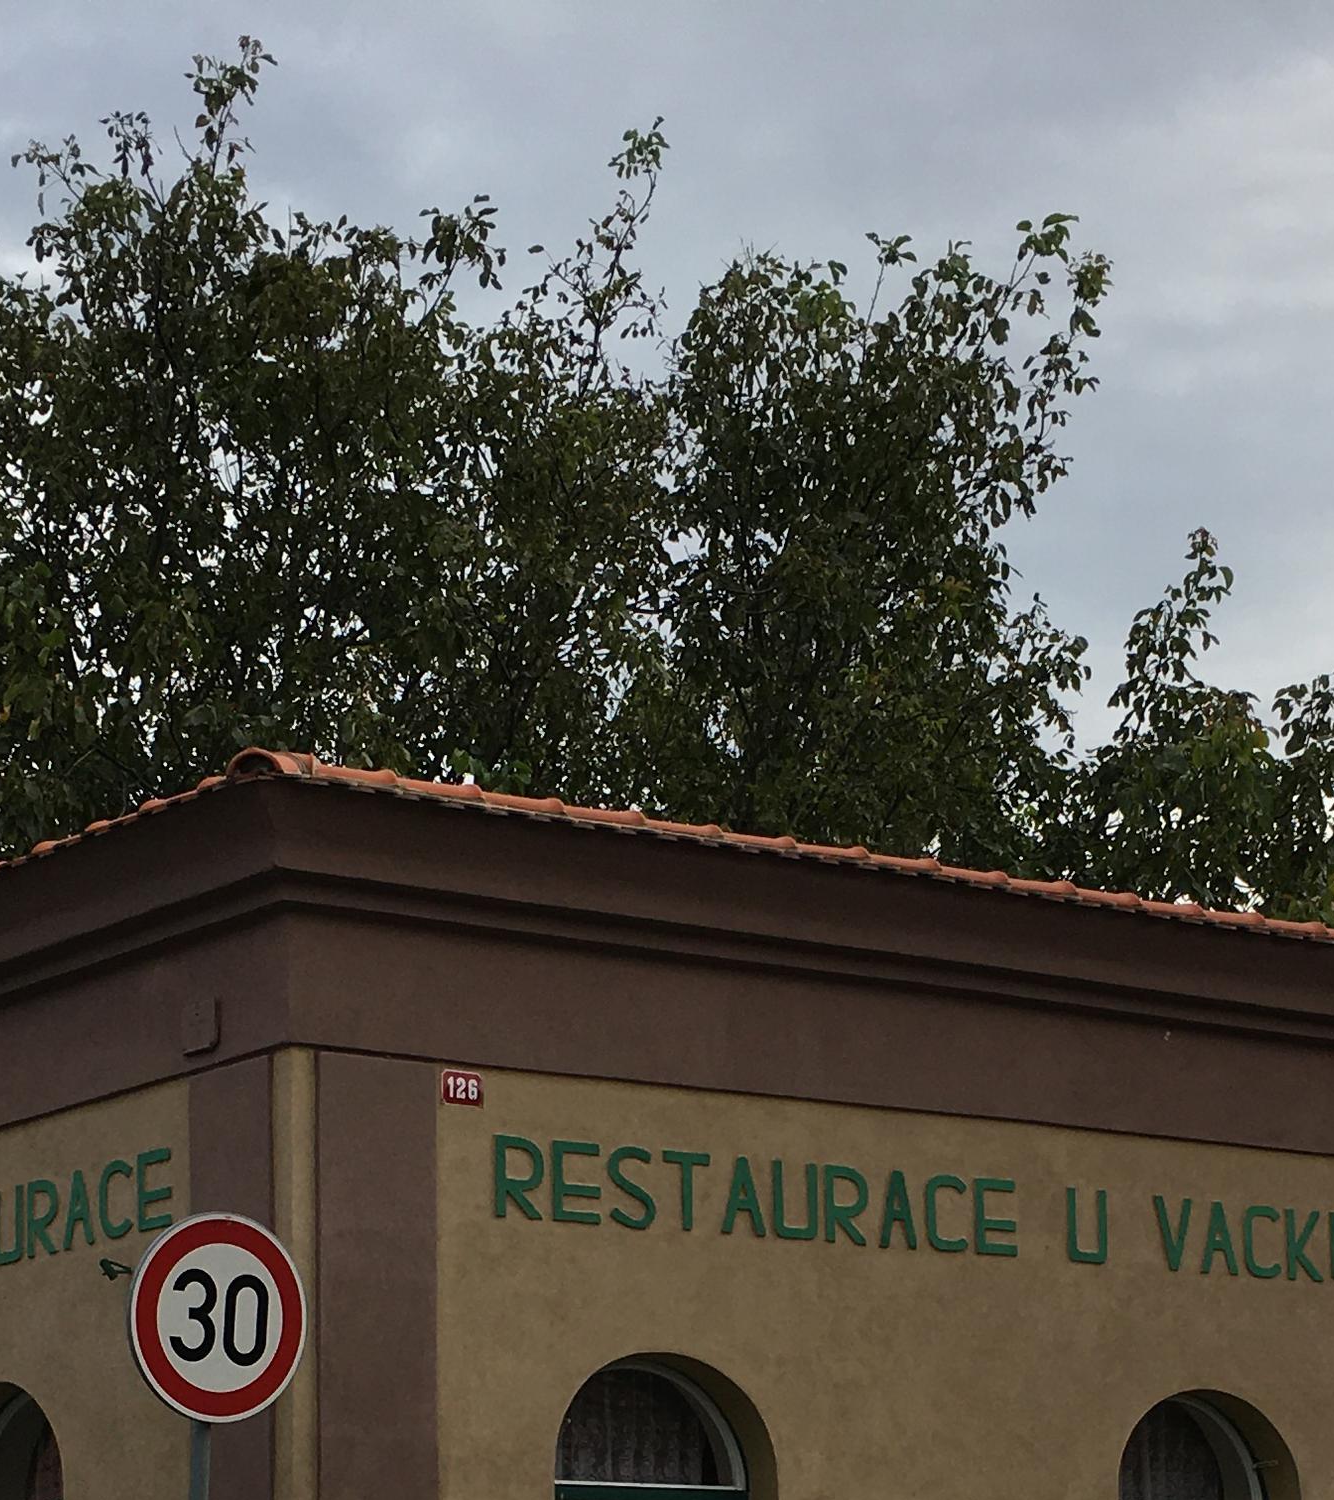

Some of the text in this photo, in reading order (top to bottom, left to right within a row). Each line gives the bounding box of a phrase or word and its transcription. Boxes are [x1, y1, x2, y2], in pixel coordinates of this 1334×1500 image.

[447, 1076, 478, 1100] 126
[493, 1133, 1018, 1257] RESTAURACE
[1066, 1186, 1108, 1264] U
[169, 1268, 269, 1367] 30
